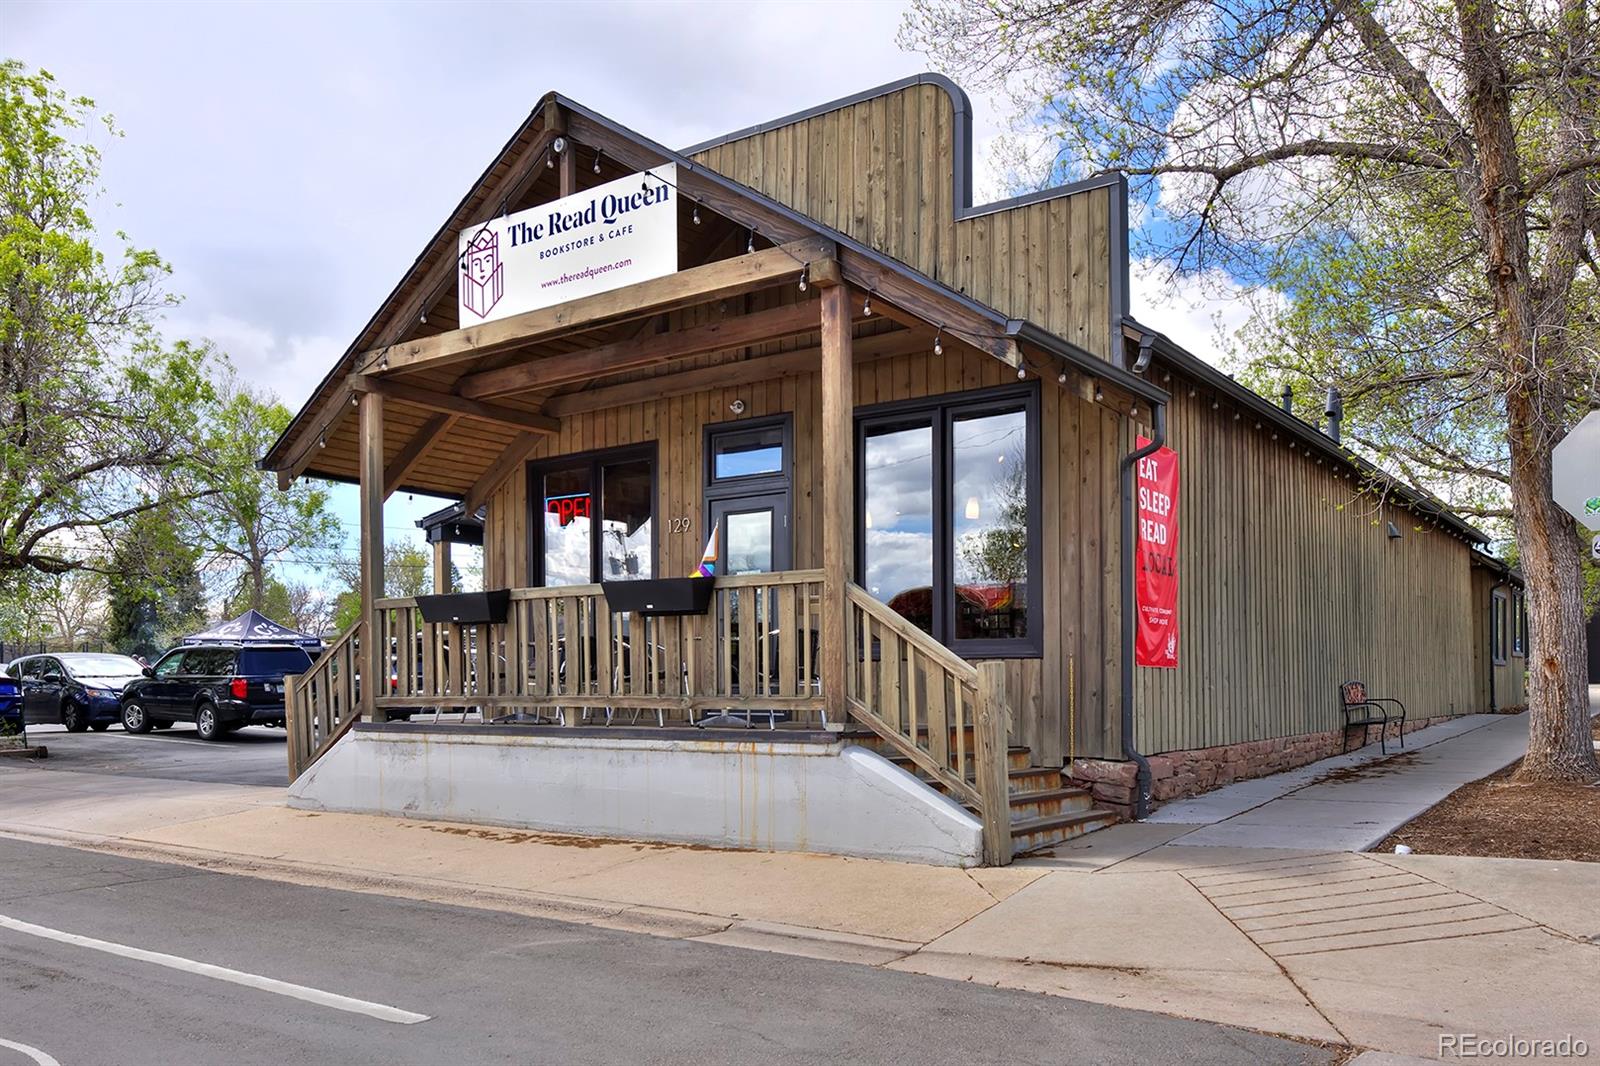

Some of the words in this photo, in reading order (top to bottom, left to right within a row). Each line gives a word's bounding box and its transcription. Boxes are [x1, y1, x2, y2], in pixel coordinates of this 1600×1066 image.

[507, 222, 544, 248] The
[548, 199, 597, 237] Read
[601, 184, 669, 225] Queen
[539, 235, 595, 260] BOOKSTORE
[598, 233, 605, 242] &
[608, 224, 633, 239] CAFE
[541, 258, 632, 289] www.thereadqueen.com
[1139, 456, 1158, 482] EAT
[1139, 486, 1171, 517] SLEEP
[668, 517, 690, 533] 129
[1140, 518, 1167, 545] READ
